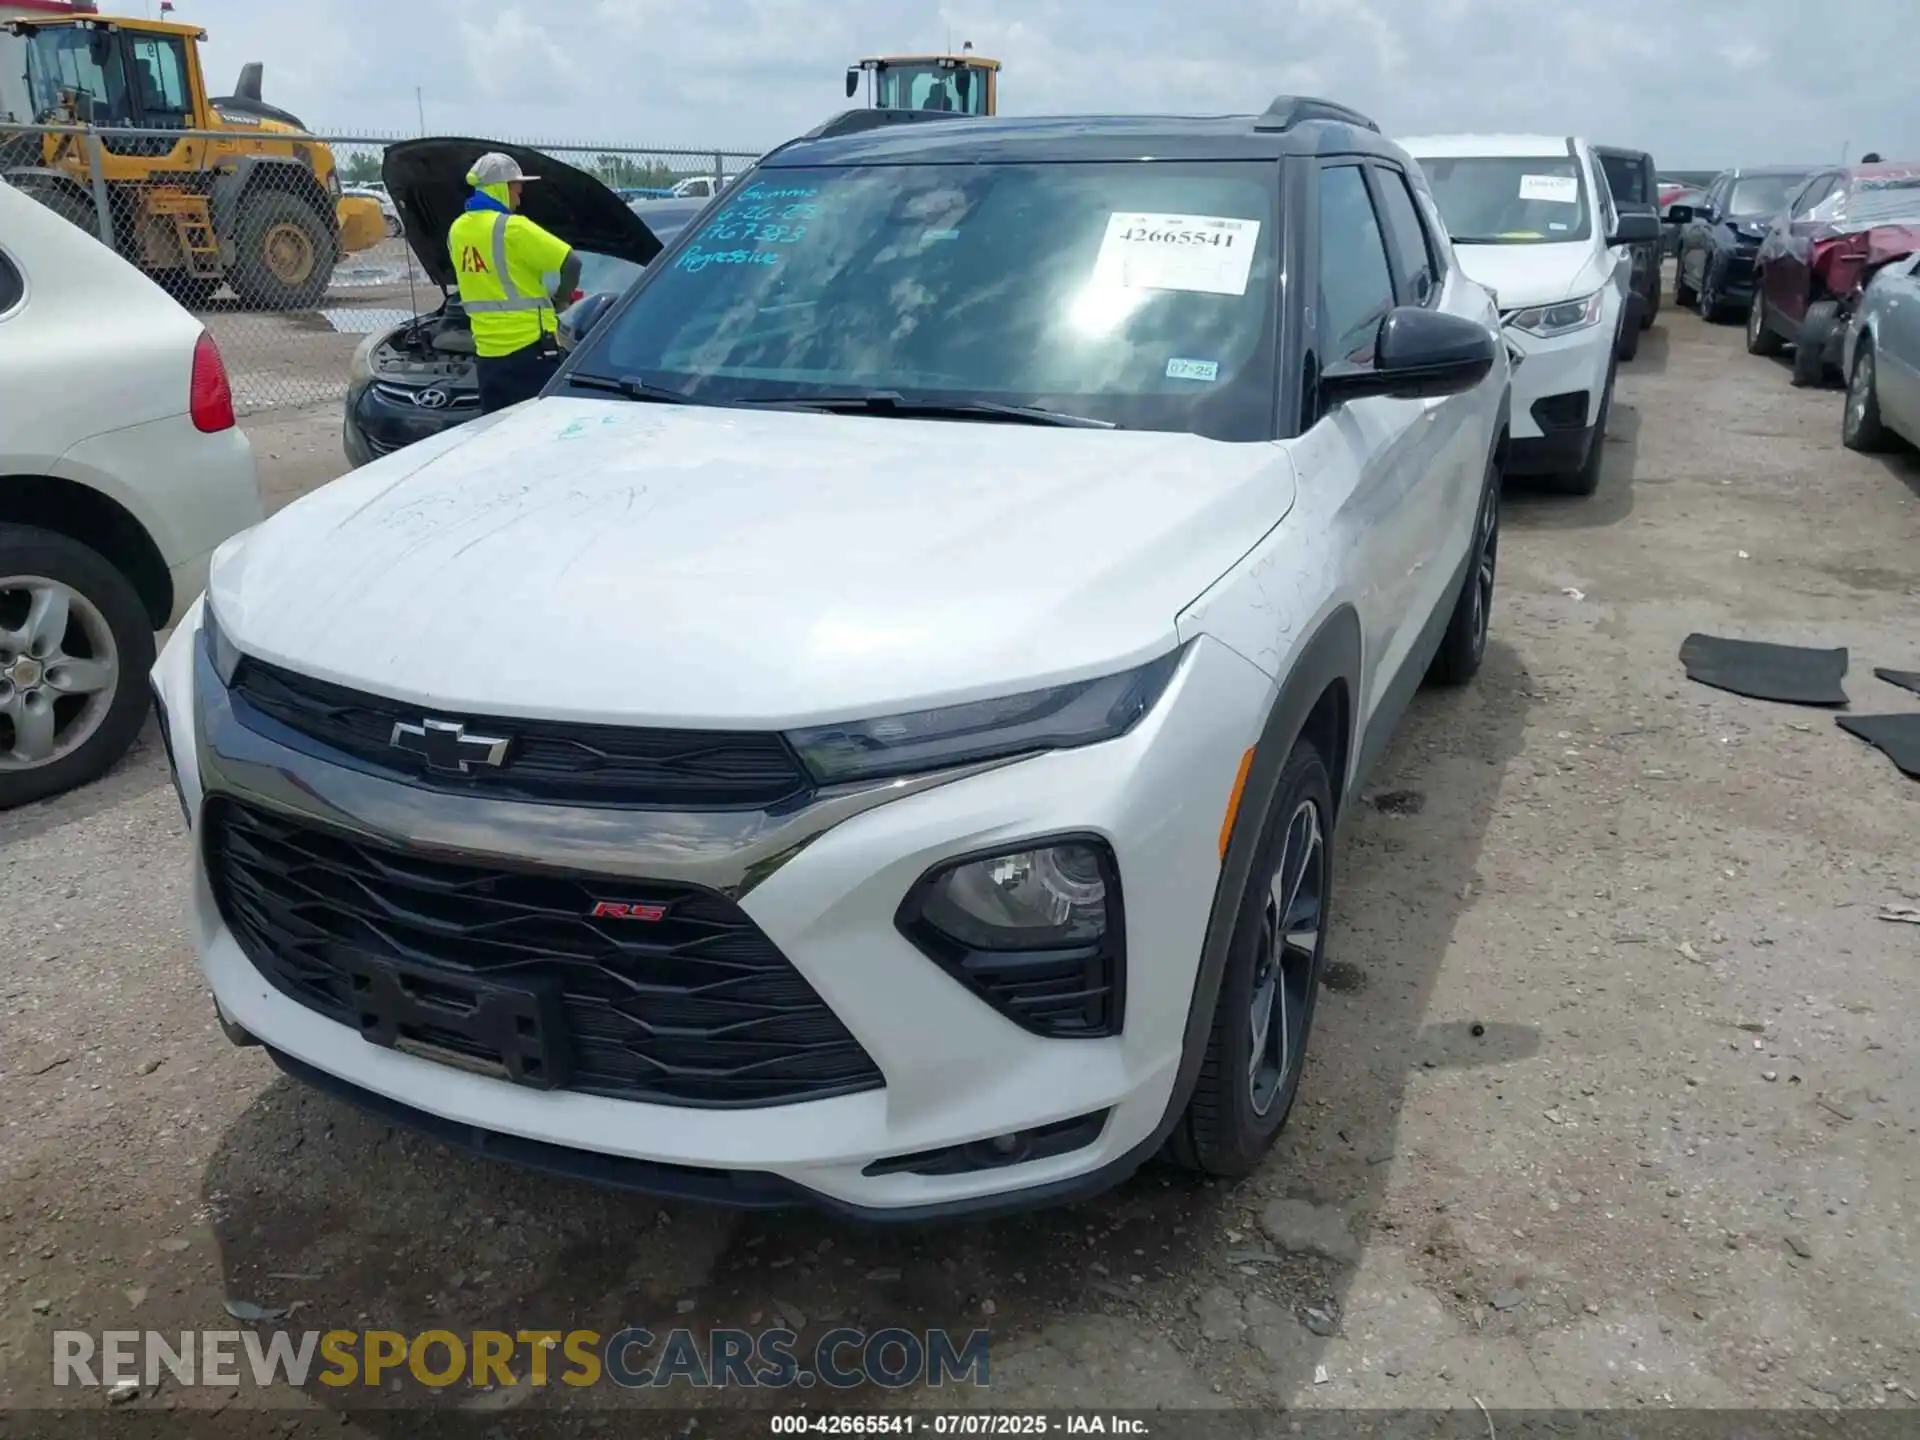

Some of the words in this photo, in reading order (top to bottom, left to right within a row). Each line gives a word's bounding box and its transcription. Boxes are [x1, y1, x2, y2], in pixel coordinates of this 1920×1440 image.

[1119, 227, 1234, 248] 42665541
[674, 245, 779, 273] Progressive
[591, 901, 667, 920] RS
